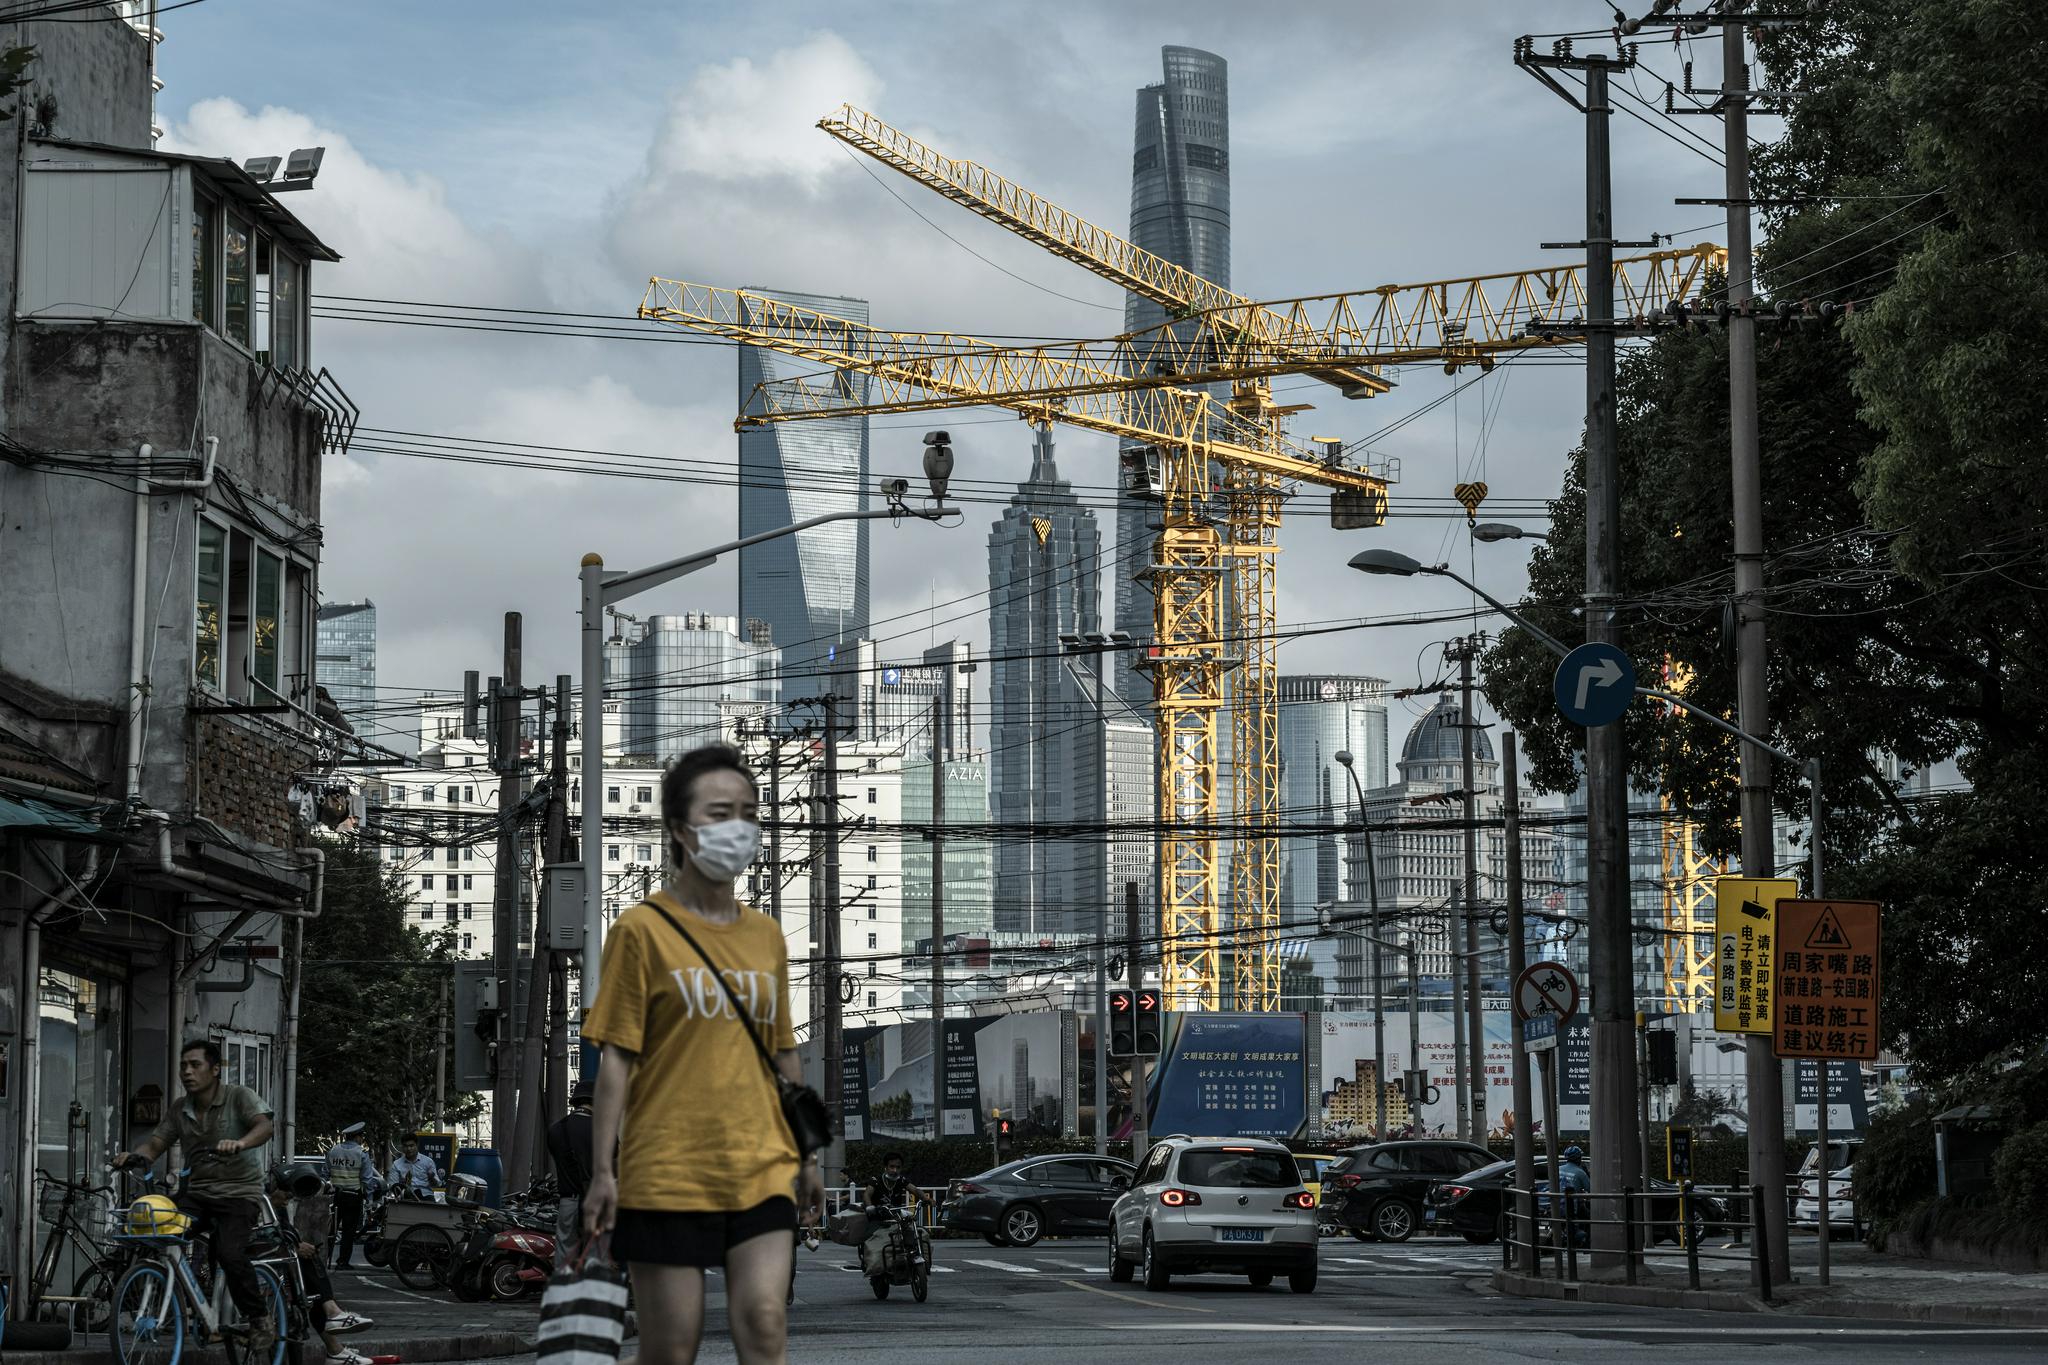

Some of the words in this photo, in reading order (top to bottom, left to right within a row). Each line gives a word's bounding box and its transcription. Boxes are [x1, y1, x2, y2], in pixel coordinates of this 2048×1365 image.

[902, 668, 943, 679] 上海银行
[948, 767, 983, 780] AZIA
[1782, 951, 1872, 976] 周家嘴路
[1738, 925, 1754, 1028] 电子警察监管
[1756, 934, 1771, 1021] 请立即驶离
[1481, 1000, 1511, 1010] 恒大中
[1784, 1004, 1868, 1027] 道路施工
[1783, 1028, 1868, 1053] 建议绕行
[1493, 1077, 1512, 1086] 更惠
